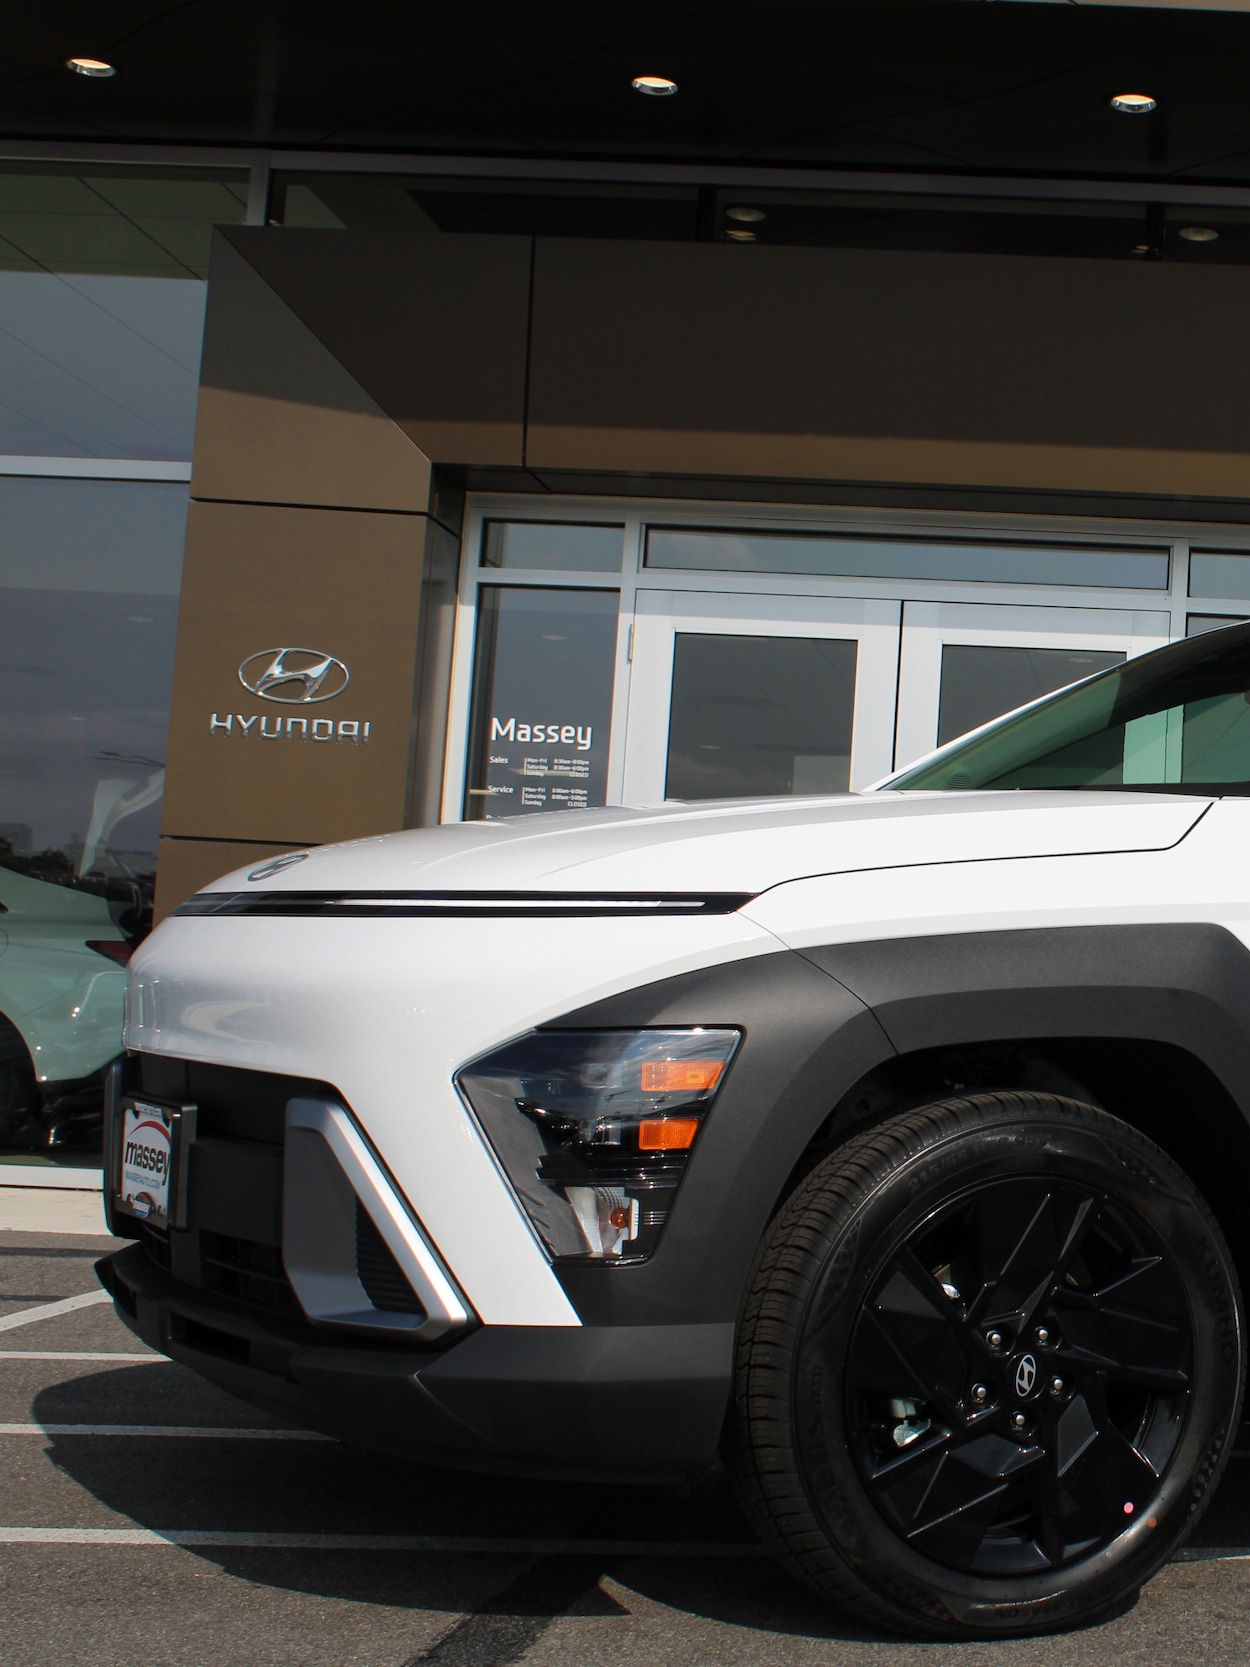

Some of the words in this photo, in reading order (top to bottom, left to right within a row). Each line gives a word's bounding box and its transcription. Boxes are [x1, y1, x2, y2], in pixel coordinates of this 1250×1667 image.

[209, 712, 372, 745] HYUNDAI
[490, 717, 593, 751] Massey
[489, 756, 509, 764] Sales
[526, 763, 549, 771] Saturday
[487, 785, 514, 793] Service
[524, 793, 547, 801] Saturday
[125, 1142, 170, 1186] massey
[1194, 1234, 1236, 1366] KUMHO
